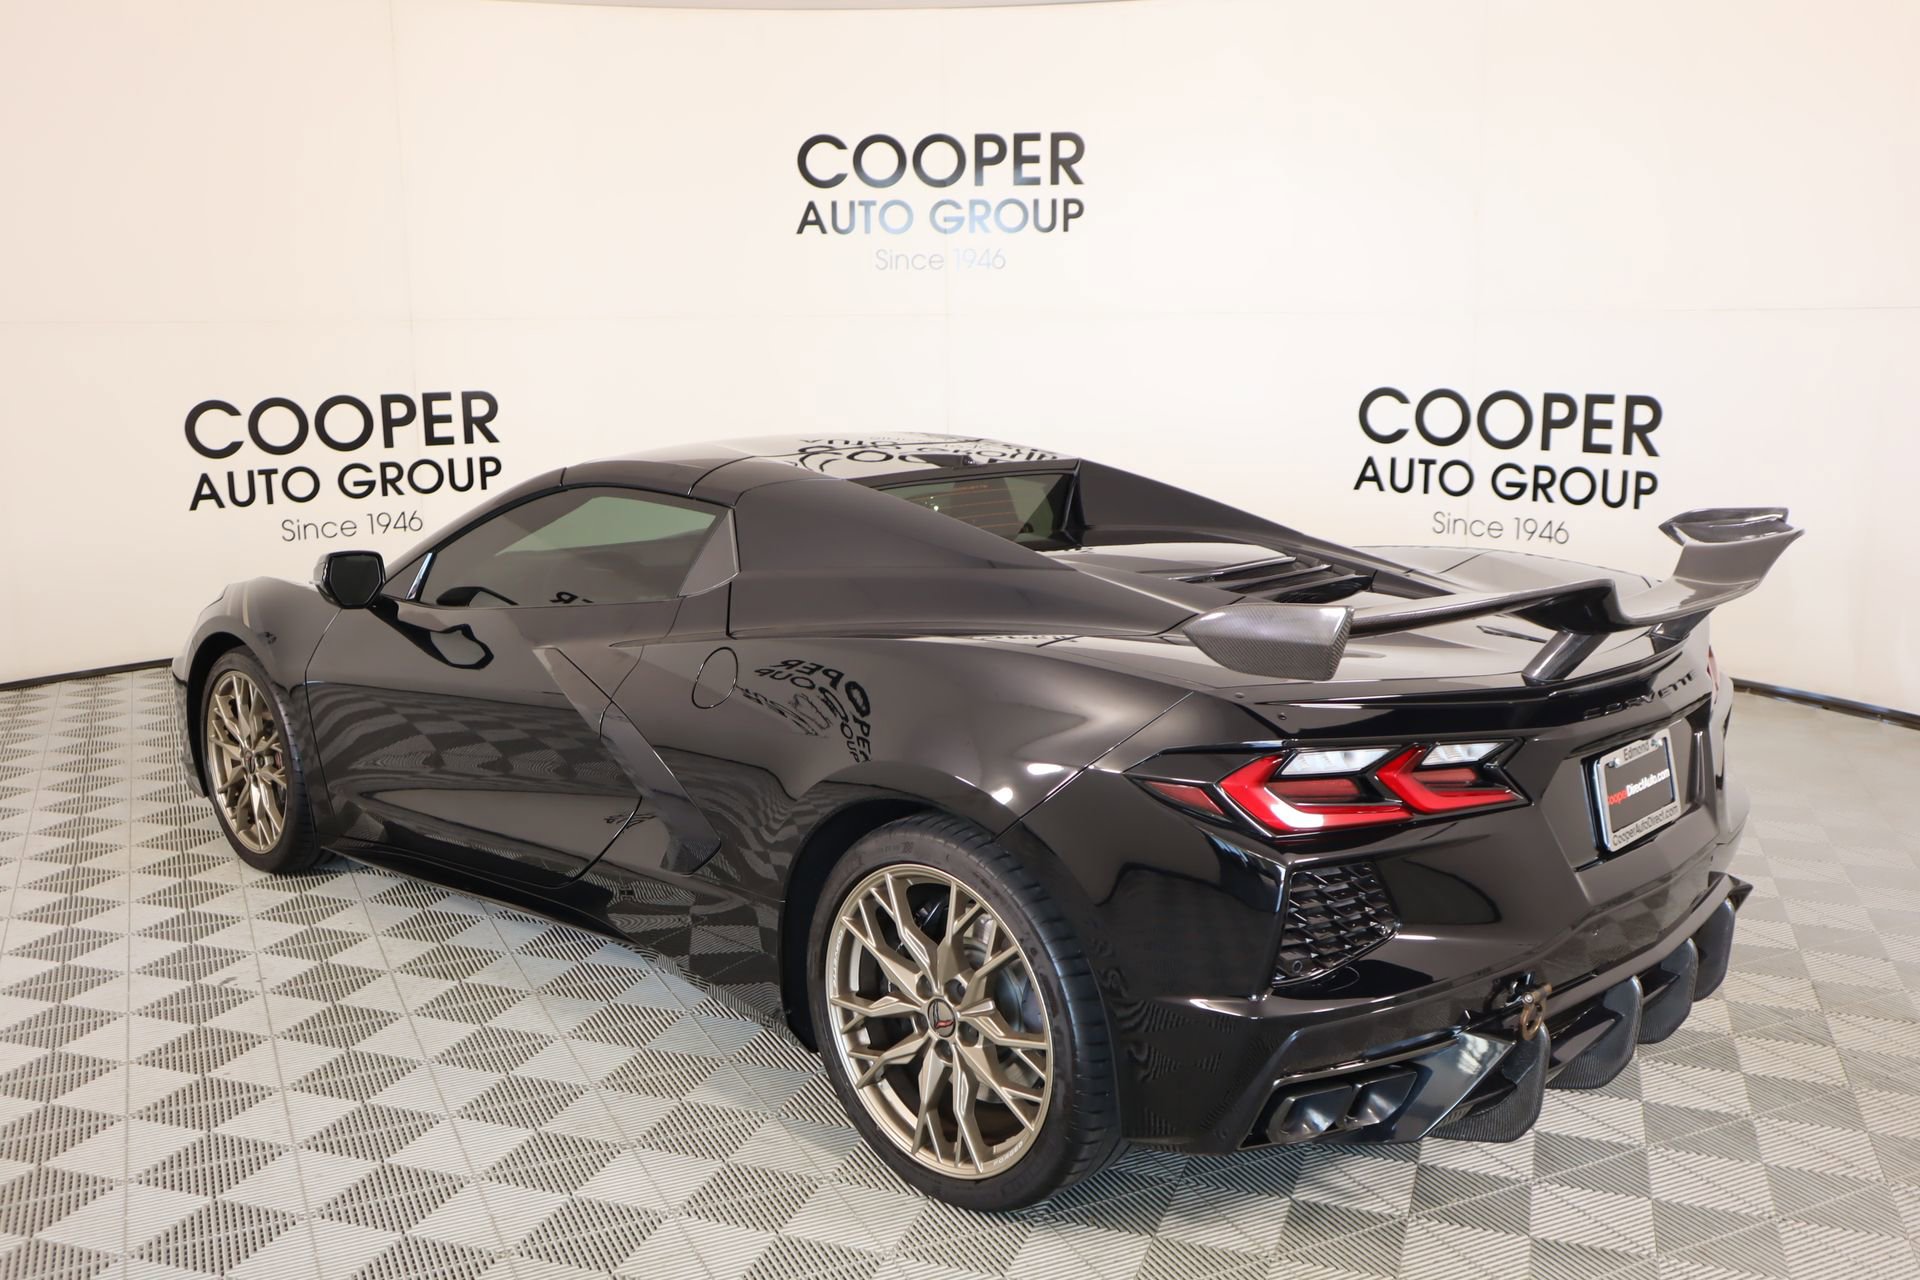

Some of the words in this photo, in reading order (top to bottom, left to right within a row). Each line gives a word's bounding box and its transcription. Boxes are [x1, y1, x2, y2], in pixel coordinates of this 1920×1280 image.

[797, 131, 1086, 188] COOPER
[796, 199, 914, 235] AUTO
[929, 198, 1085, 235] GROUP
[875, 248, 945, 271] Since
[954, 248, 1007, 271] 1946
[184, 390, 500, 460] COOPER
[1358, 386, 1663, 457] COOPER
[189, 466, 321, 511] AUTO
[337, 456, 502, 499] GROUP
[1353, 456, 1475, 497] AUTO
[1491, 463, 1659, 510] GROUP
[281, 518, 358, 542] Since
[366, 510, 424, 535] 1946
[1431, 511, 1504, 540] Since
[1514, 517, 1570, 545] 1946
[1583, 669, 1697, 719] CORVETTE
[1623, 742, 1650, 761] Edmond
[1612, 806, 1680, 847] CooperAutoDirect.com
